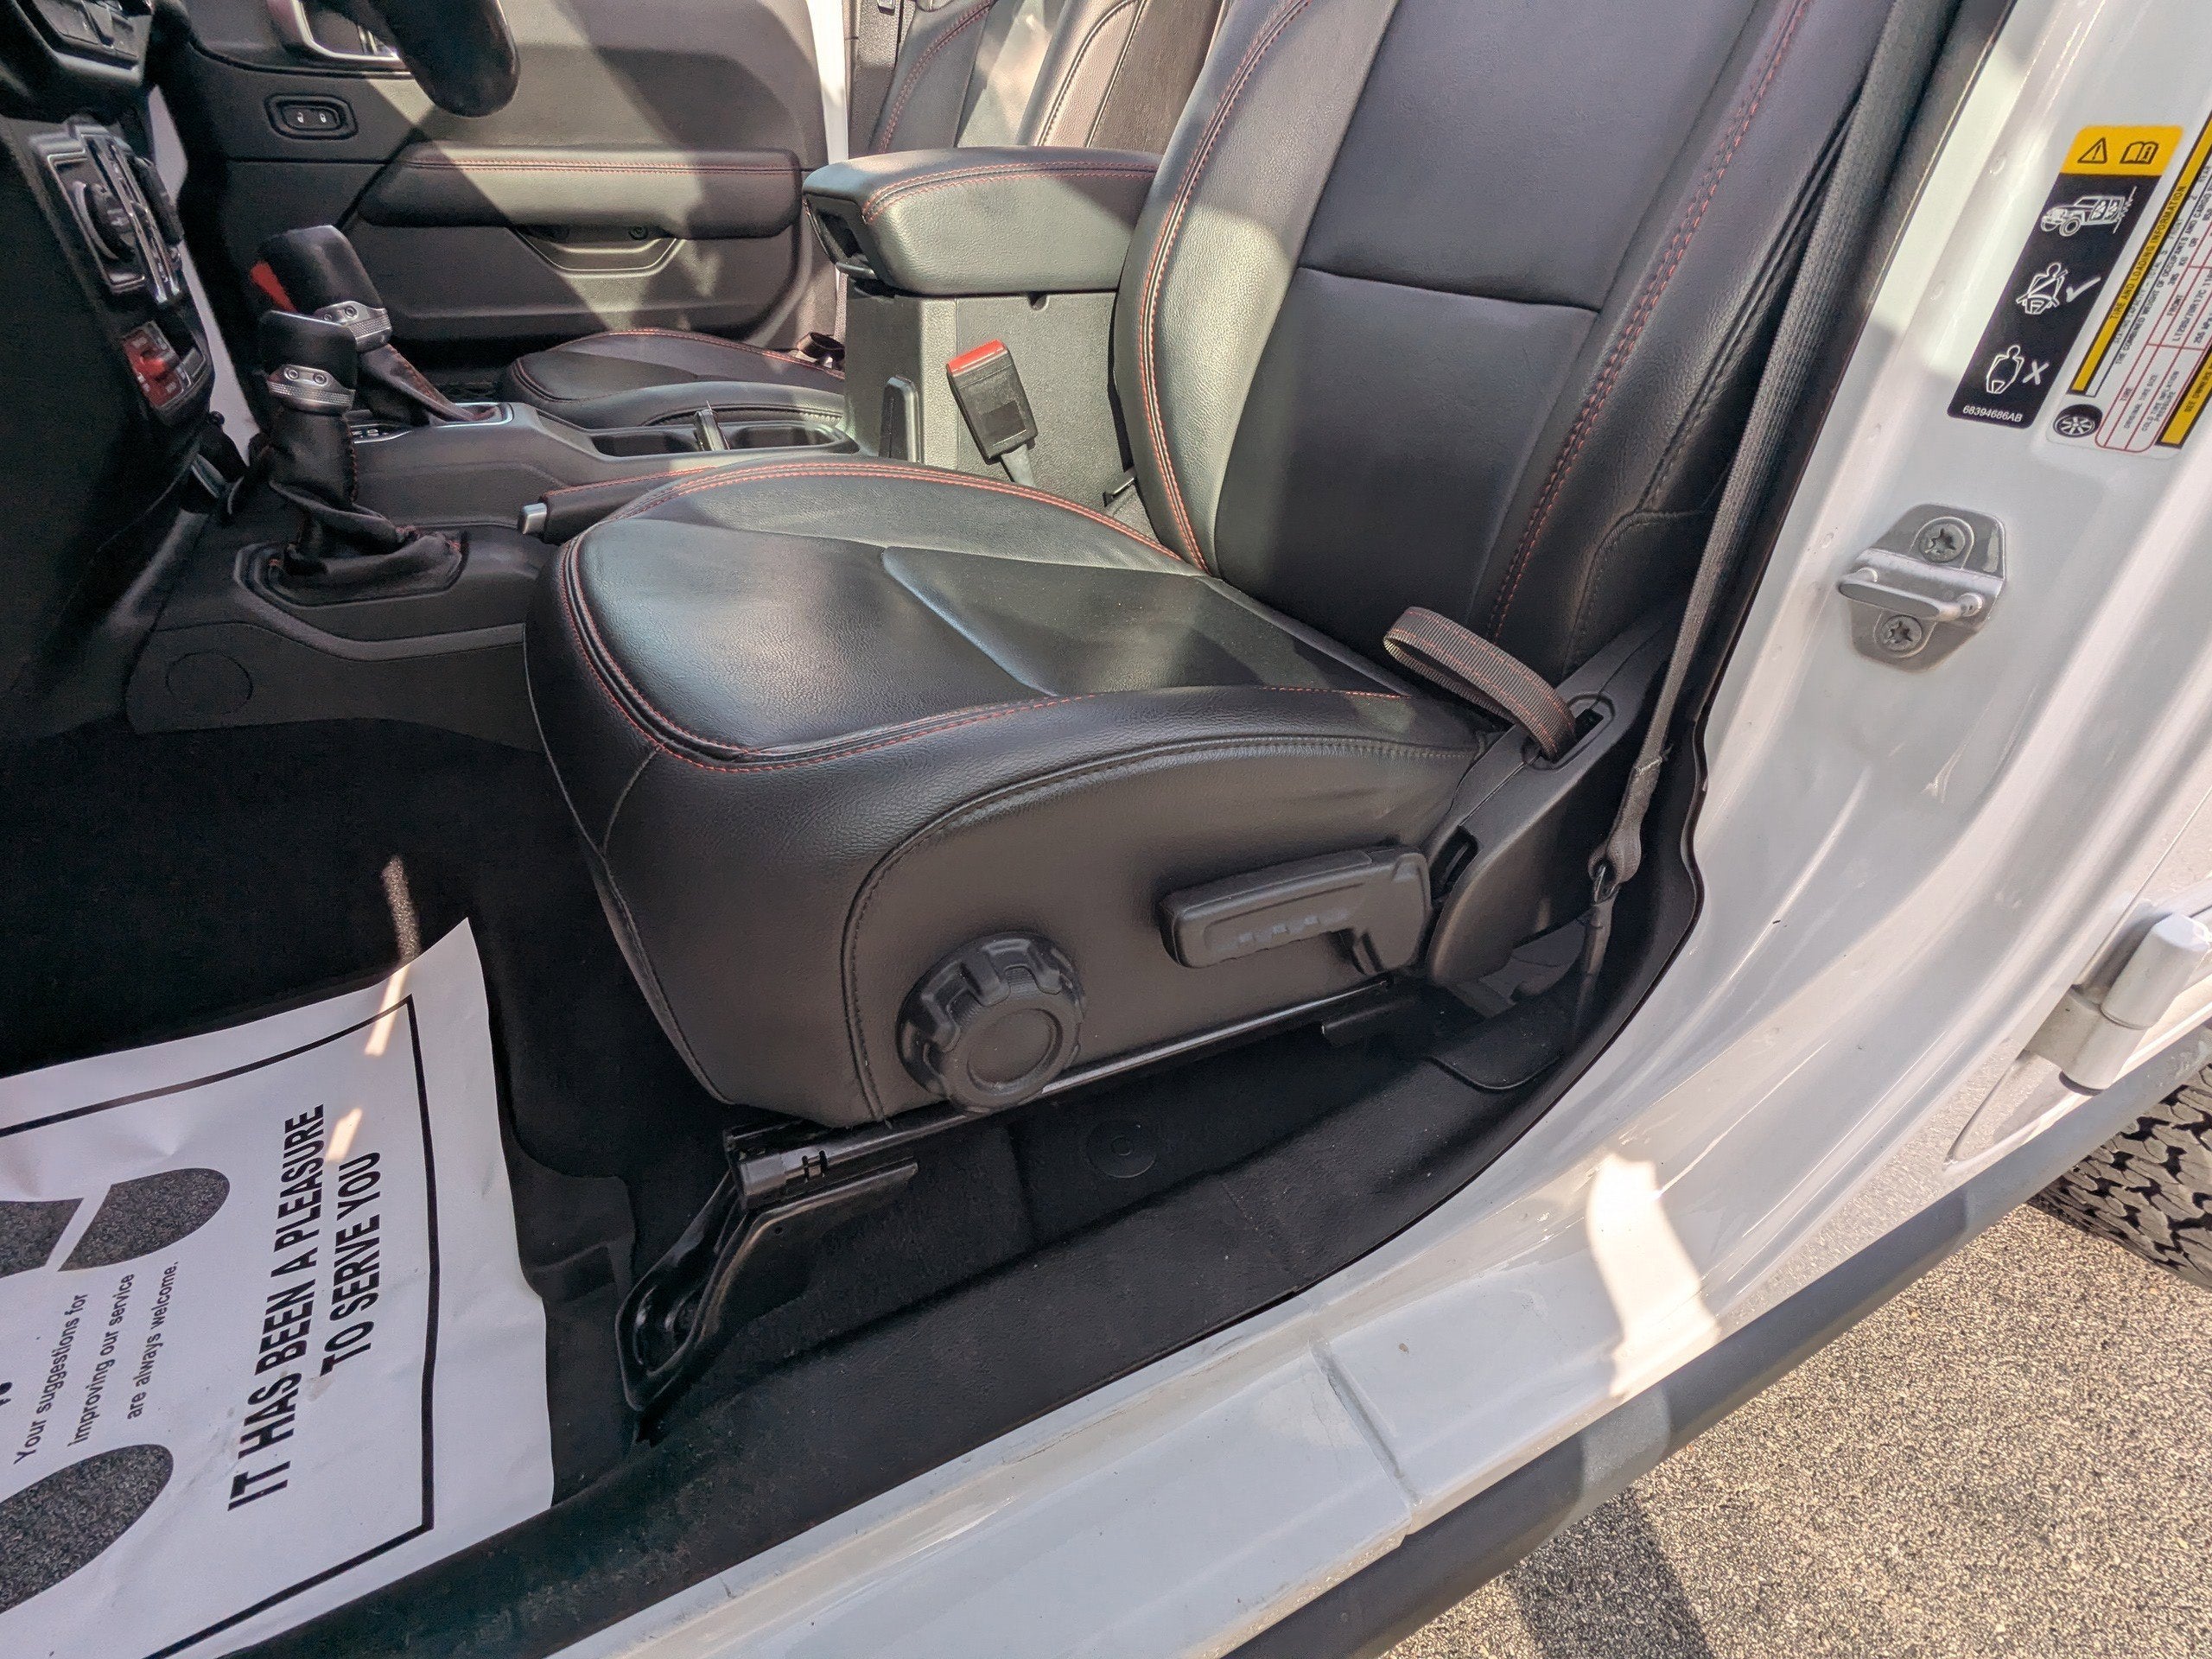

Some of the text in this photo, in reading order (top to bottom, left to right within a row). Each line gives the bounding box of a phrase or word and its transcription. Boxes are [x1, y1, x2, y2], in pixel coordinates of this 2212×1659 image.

[2191, 193, 2212, 218] CARGO
[2183, 219, 2198, 234] AND
[2108, 184, 2187, 319] TIRE AND LOADING INFORMATION
[2160, 236, 2189, 277] OCCUPANTS
[2187, 237, 2199, 247] OR
[2140, 289, 2160, 315] WEIGHT
[2164, 294, 2183, 316] FRONT
[2120, 316, 2146, 351] COMBINED
[2114, 352, 2127, 364] THE
[2119, 387, 2133, 401] TIRE
[1962, 404, 2023, 423] 68394686AB
[320, 1152, 381, 1376] TO SERVE YOU
[99, 1331, 119, 1357] our
[109, 1274, 135, 1326] service
[227, 1104, 324, 1512] IT HAS BEEN A PLEASURE
[127, 1262, 179, 1420] are always welcome.
[14, 1294, 88, 1465] Your suggestions for
